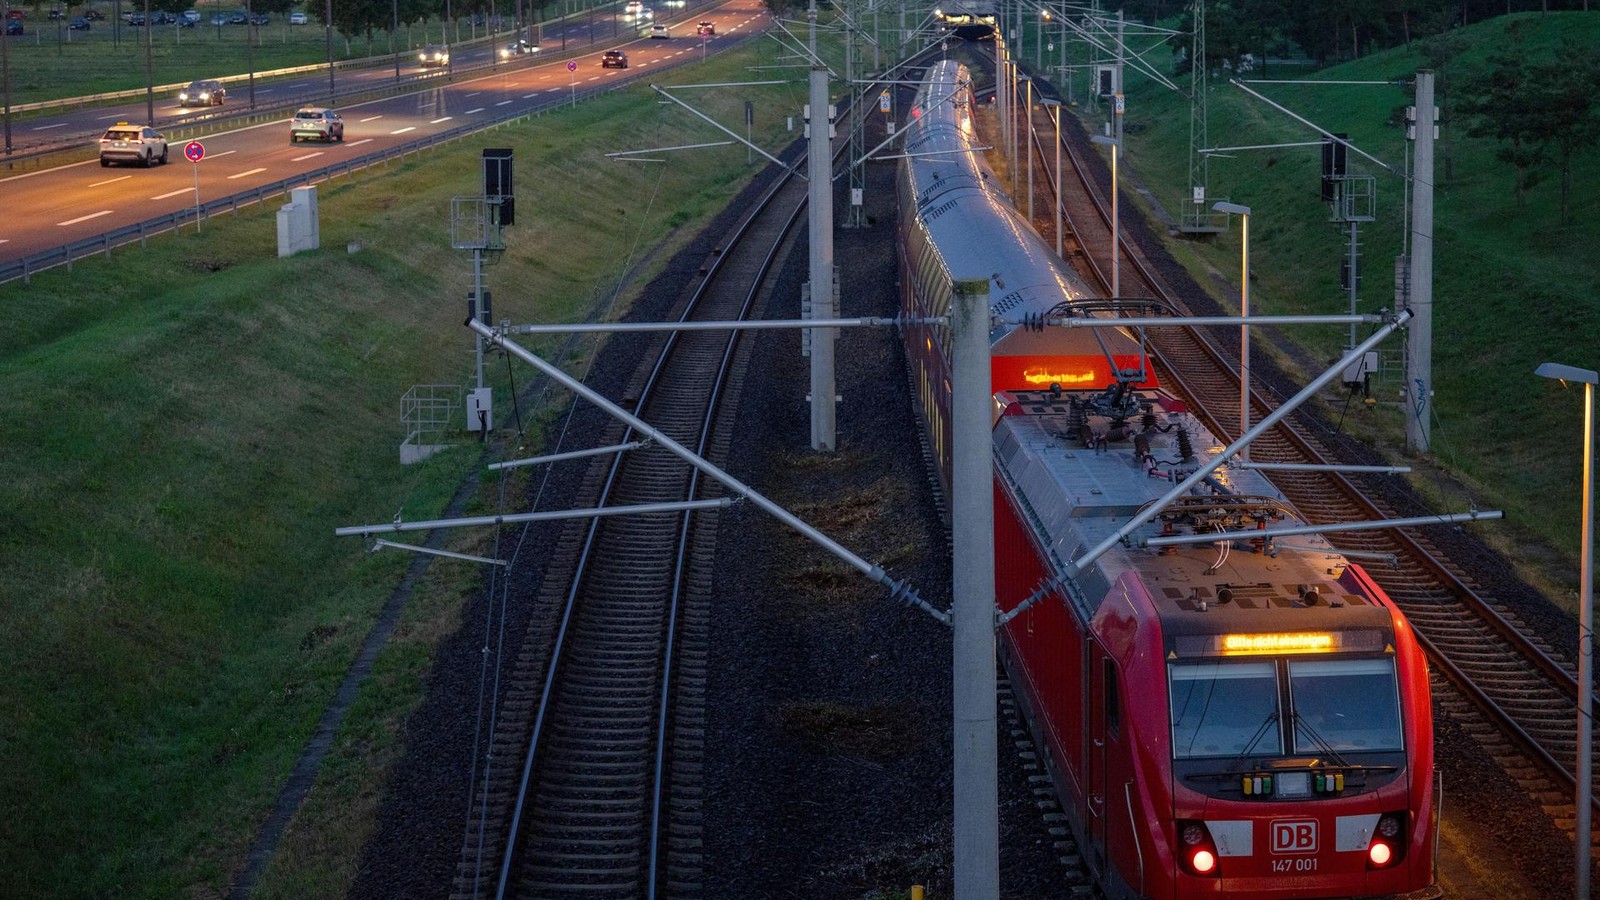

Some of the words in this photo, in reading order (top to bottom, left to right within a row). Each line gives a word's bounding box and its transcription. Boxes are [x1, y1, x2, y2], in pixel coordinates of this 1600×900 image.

[1254, 635, 1278, 647] nicht
[1276, 825, 1313, 849] DB
[1271, 860, 1293, 872] 147
[1296, 858, 1318, 871] 001
